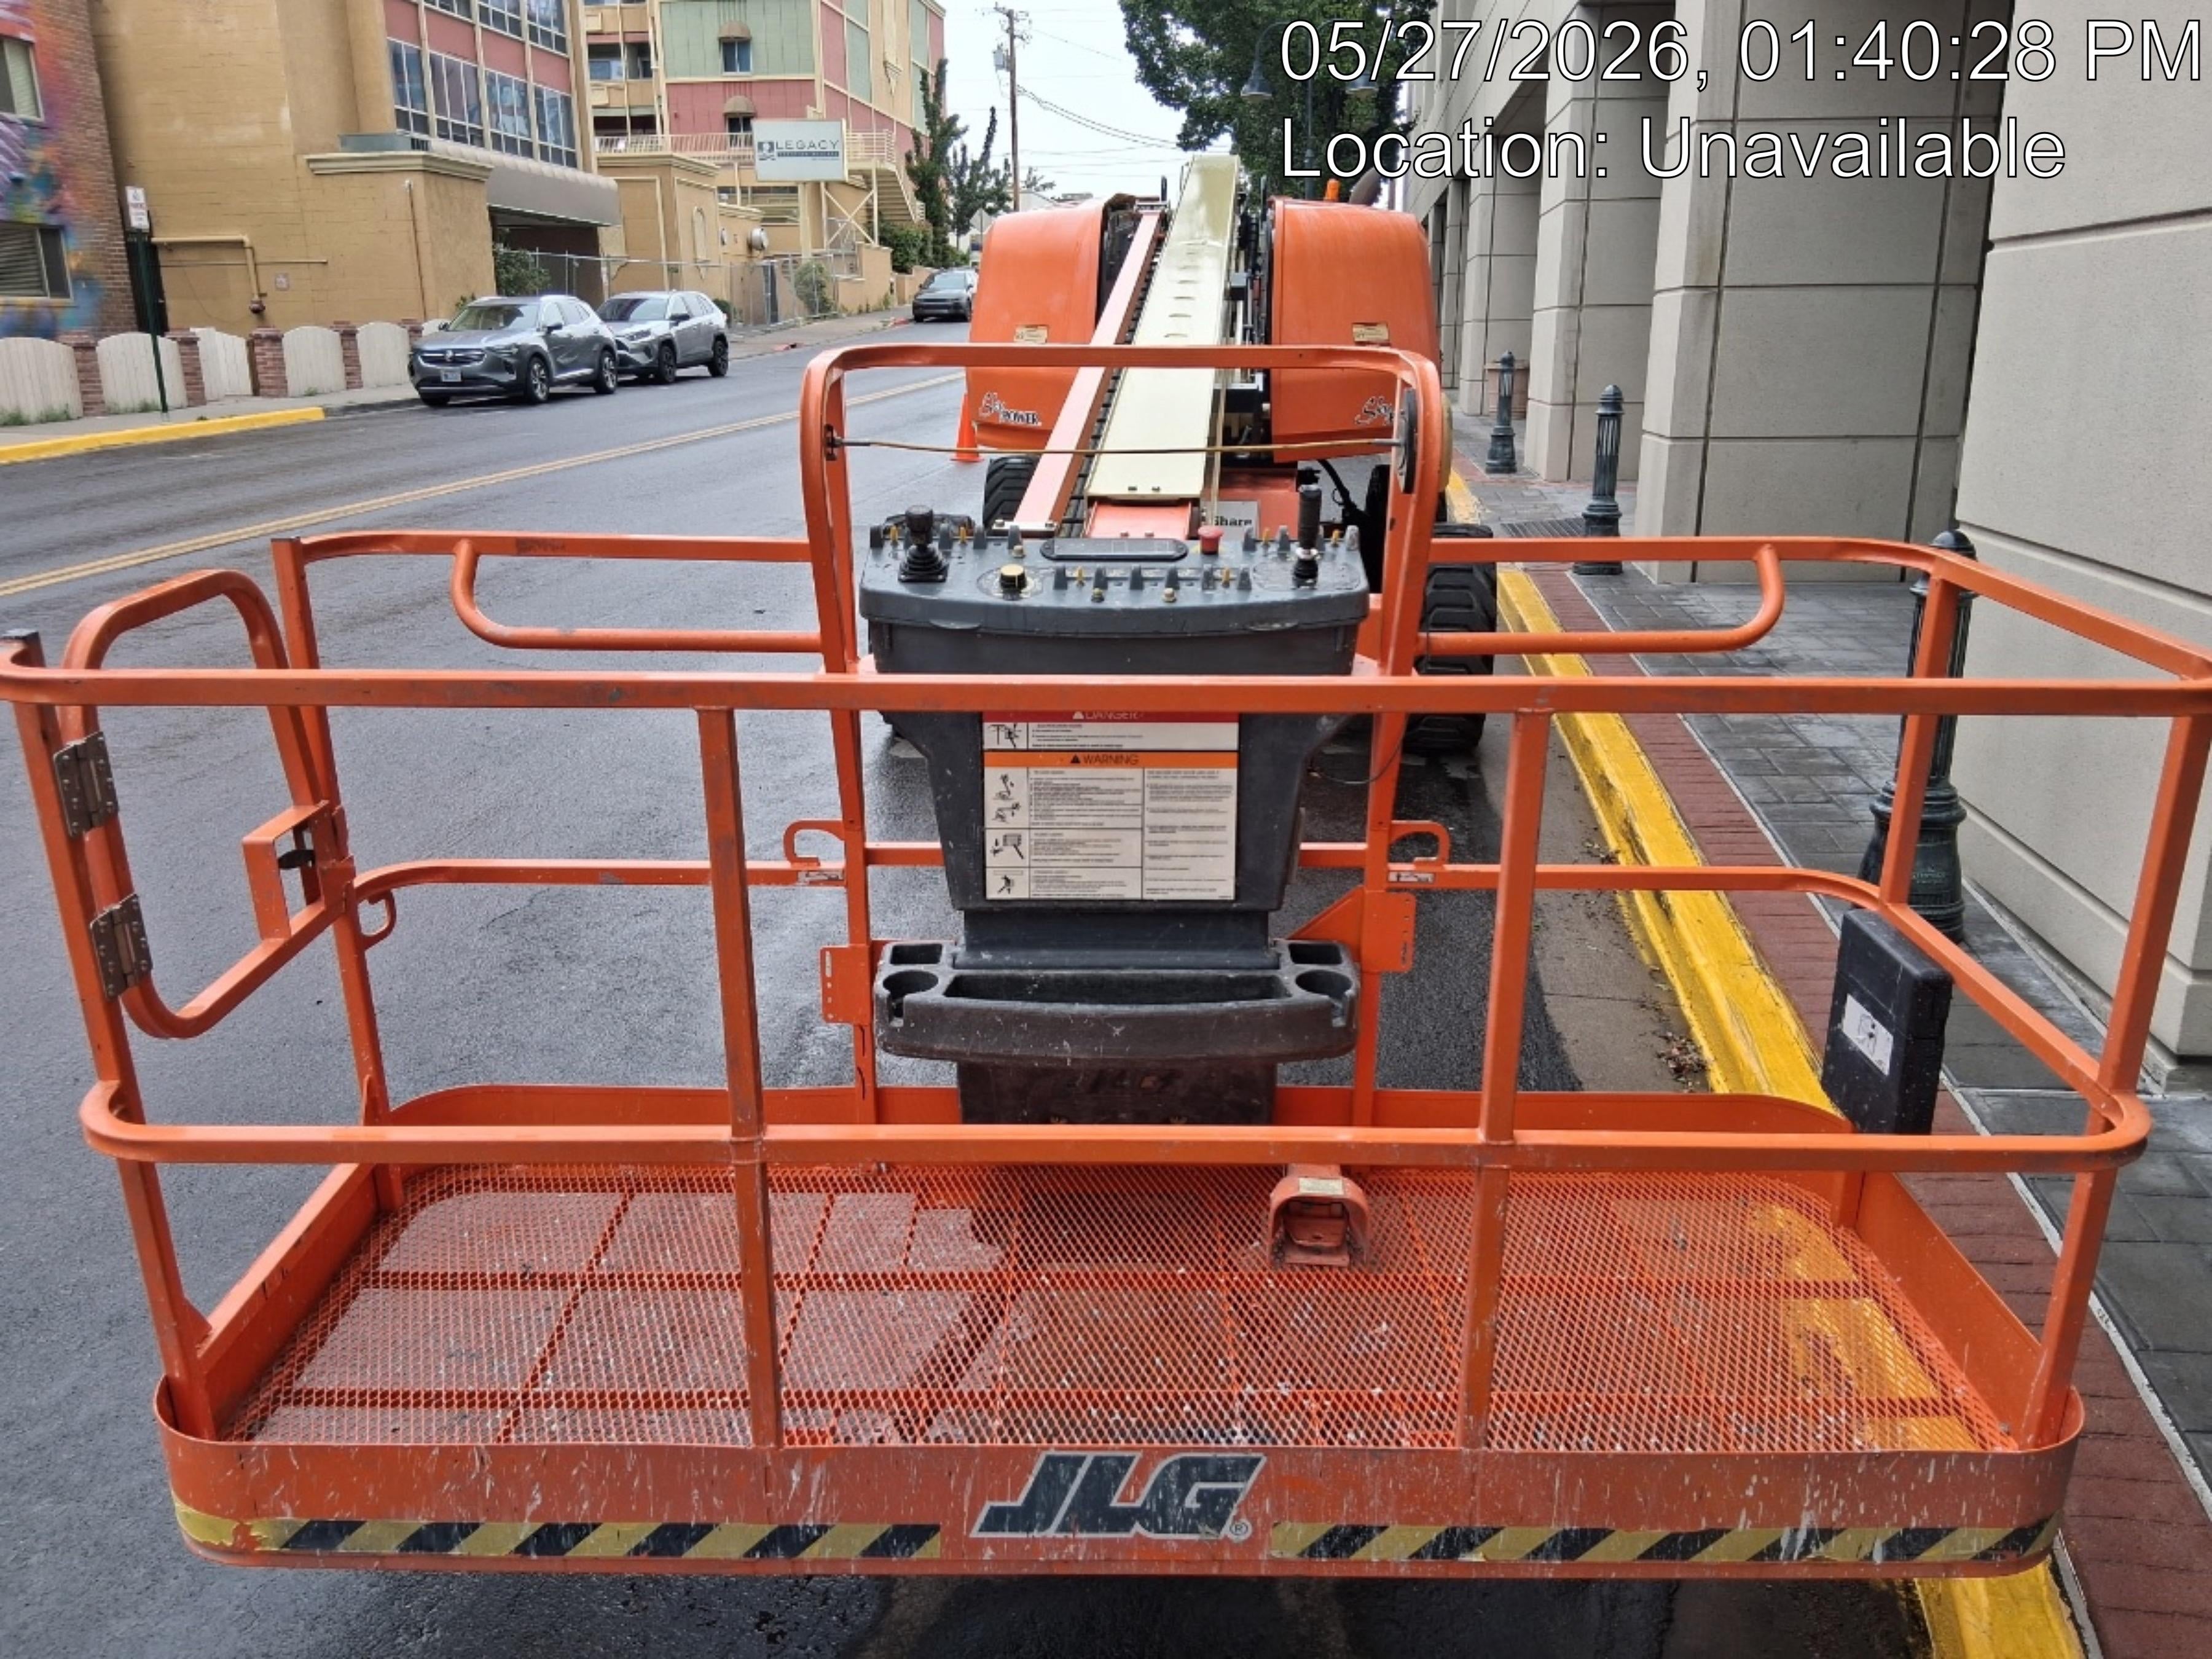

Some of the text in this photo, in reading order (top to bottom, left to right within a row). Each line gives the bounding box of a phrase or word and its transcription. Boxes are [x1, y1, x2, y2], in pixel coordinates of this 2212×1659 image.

[775, 139, 839, 150] LEGACY
[1083, 754, 1139, 766] WARNING
[970, 1450, 1267, 1540] JLG
